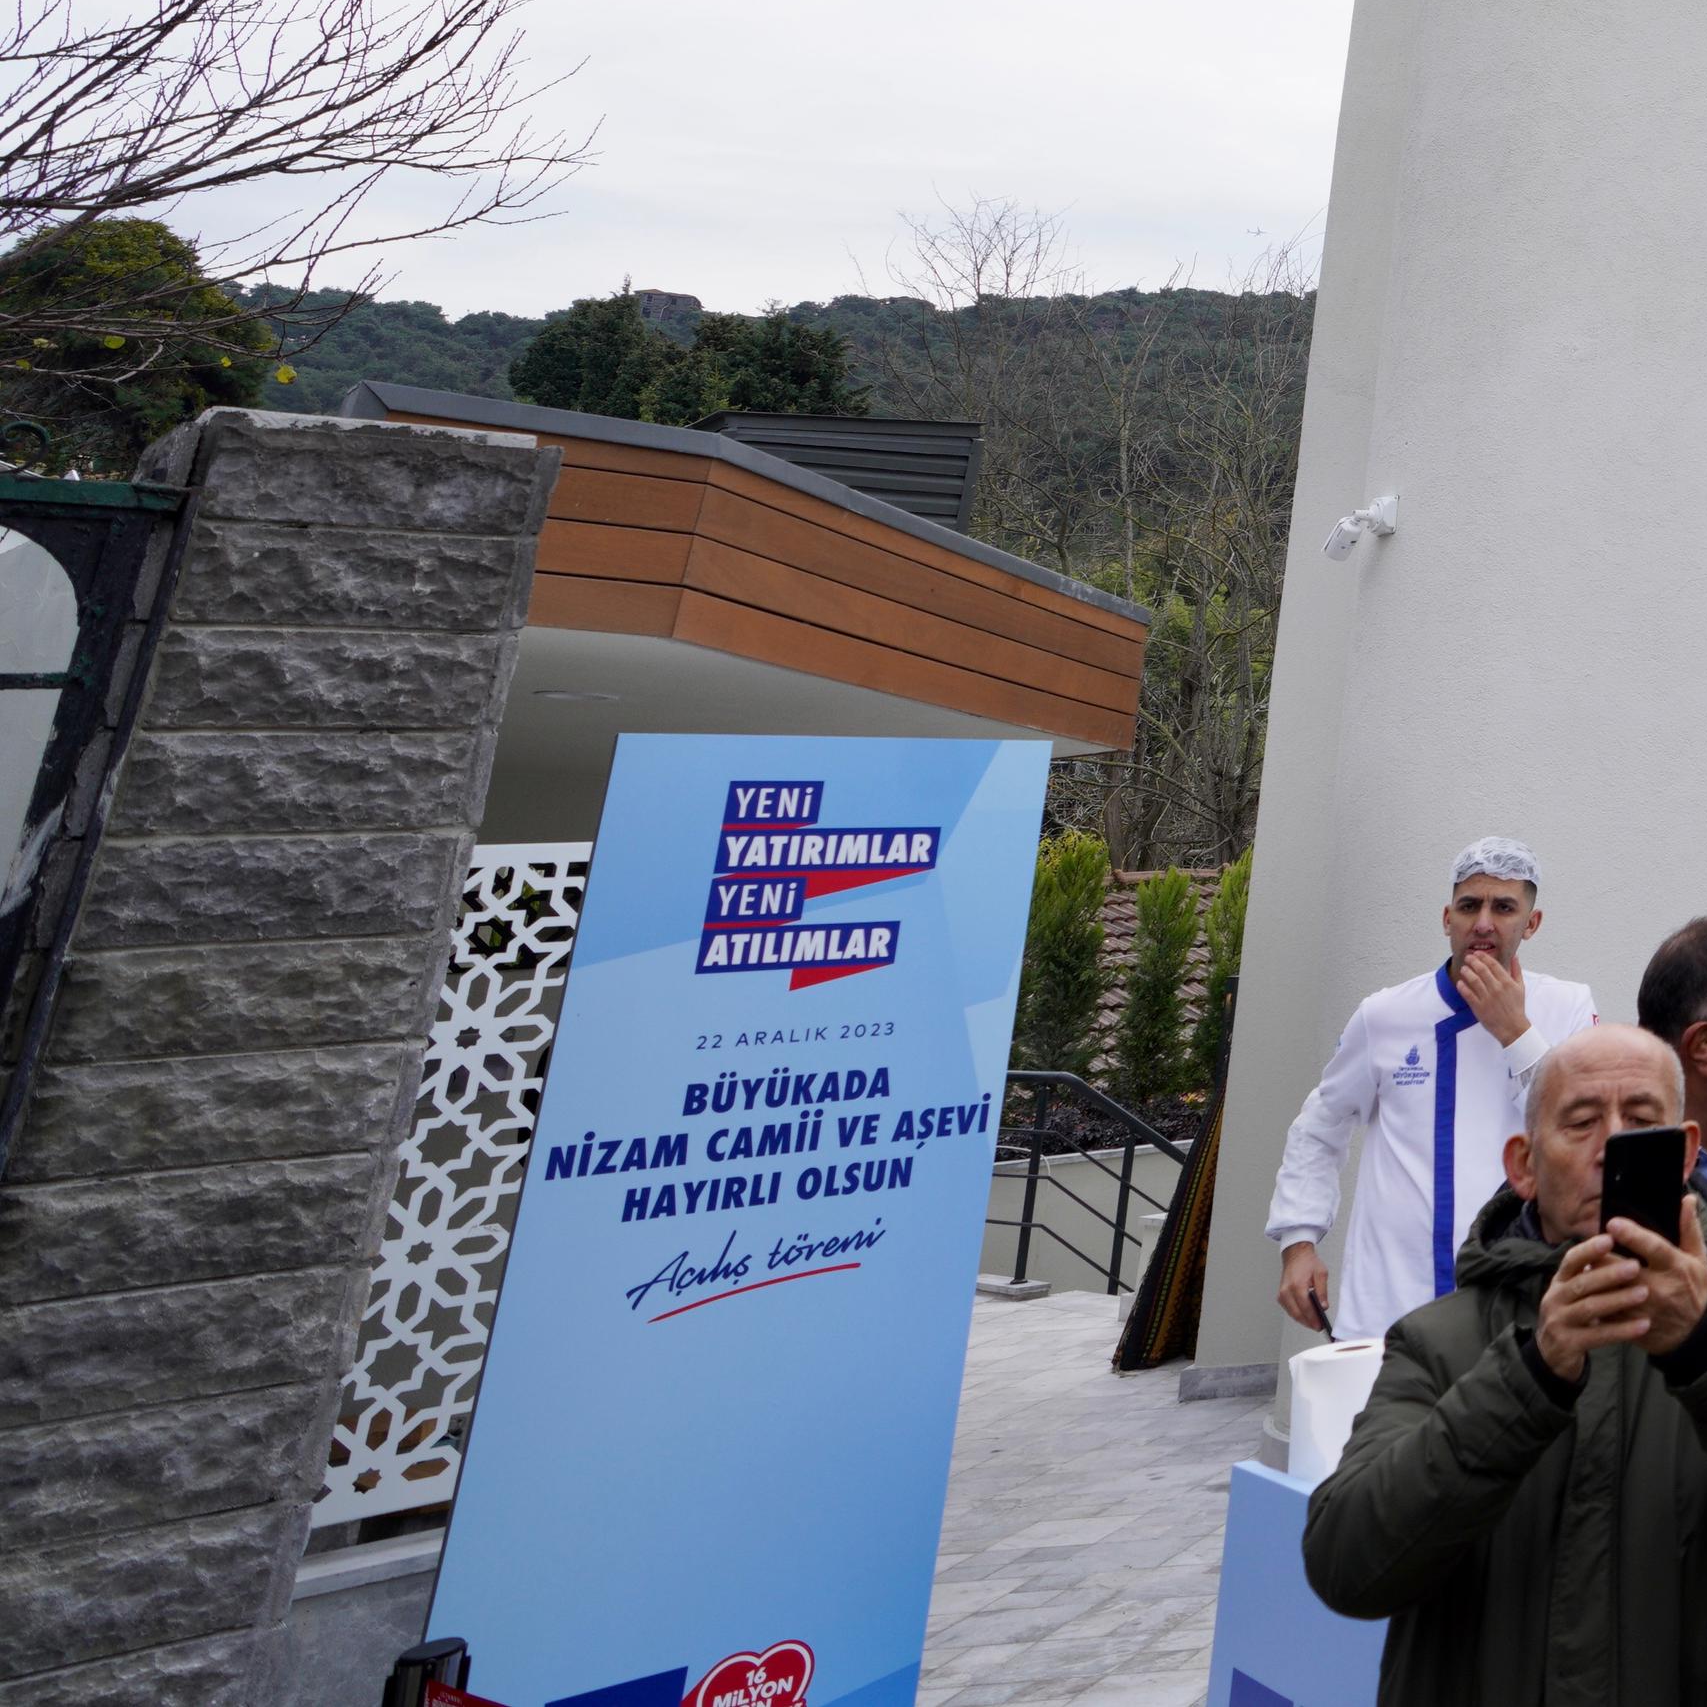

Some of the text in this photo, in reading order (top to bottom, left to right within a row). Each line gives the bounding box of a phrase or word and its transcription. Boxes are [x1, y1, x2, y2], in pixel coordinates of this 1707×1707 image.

[725, 834, 932, 868] YATIRIMLAR
[702, 927, 892, 968] ATILIMLAR
[696, 1021, 896, 1051] 22 ARALIK 2023
[682, 1066, 891, 1117] BÜYÜKADA
[544, 1093, 992, 1181] NİZAM CAMİİ VE AŞEVİ
[621, 1157, 914, 1223] HAYIRLI OLSUN
[626, 1218, 886, 1310] Açılış töreni
[746, 1666, 768, 1687] 16
